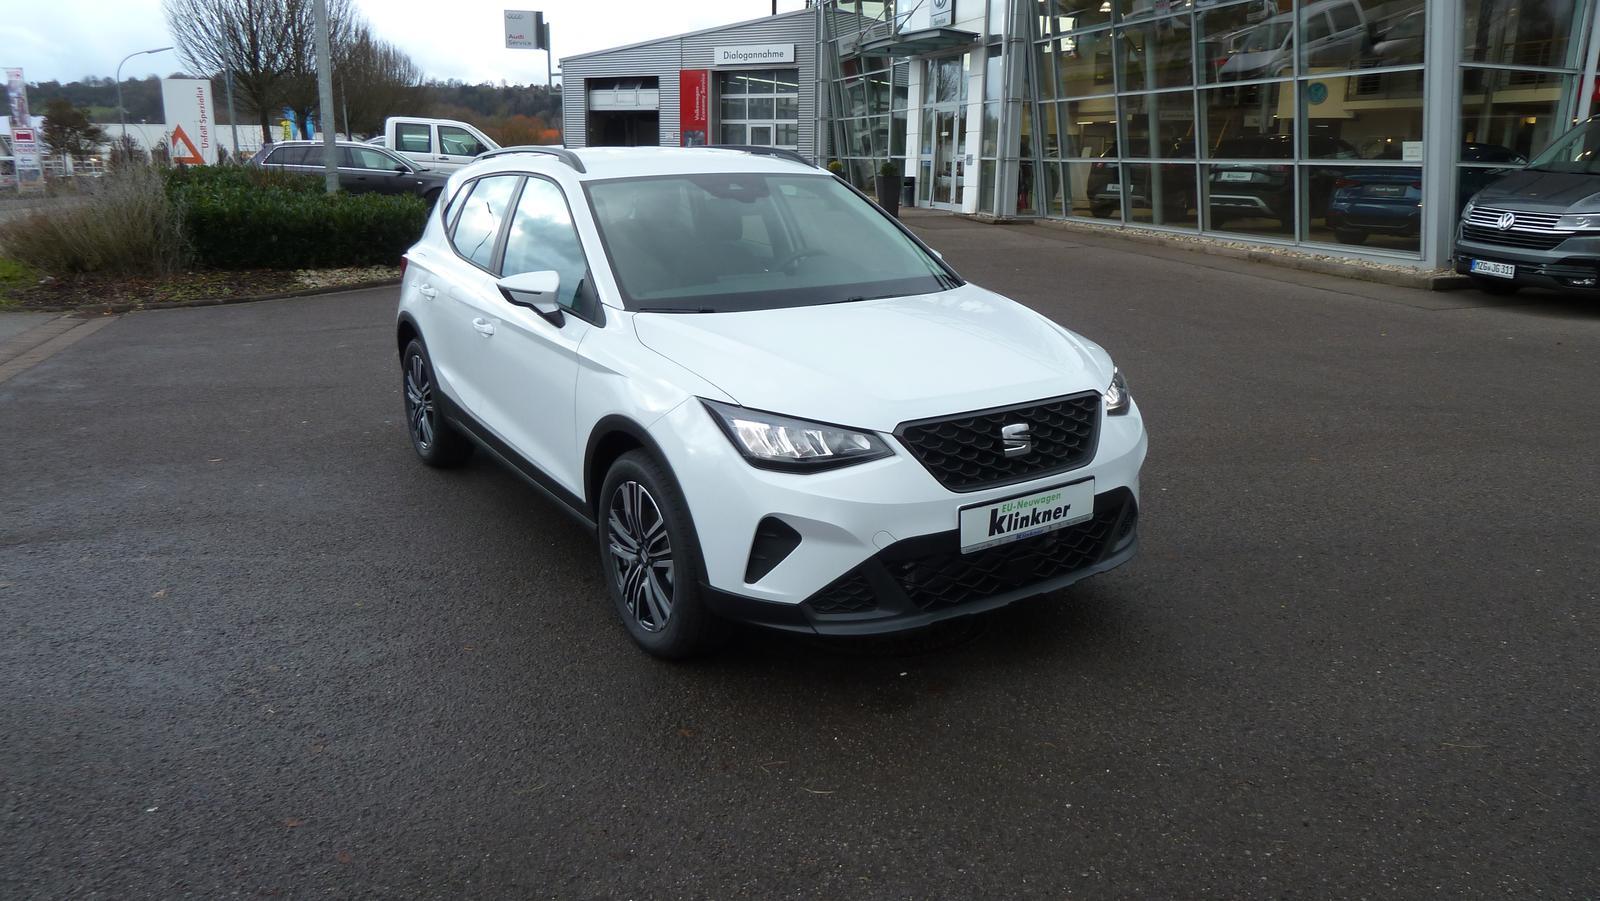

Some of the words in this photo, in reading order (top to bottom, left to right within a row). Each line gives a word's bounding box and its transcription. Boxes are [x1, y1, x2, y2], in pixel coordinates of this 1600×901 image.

[723, 49, 785, 61] Dialogannahme
[196, 87, 207, 124] Spezialist
[200, 126, 209, 149] Unfall
[1501, 264, 1513, 275] 311
[1001, 493, 1062, 513] EU-Neuwagen
